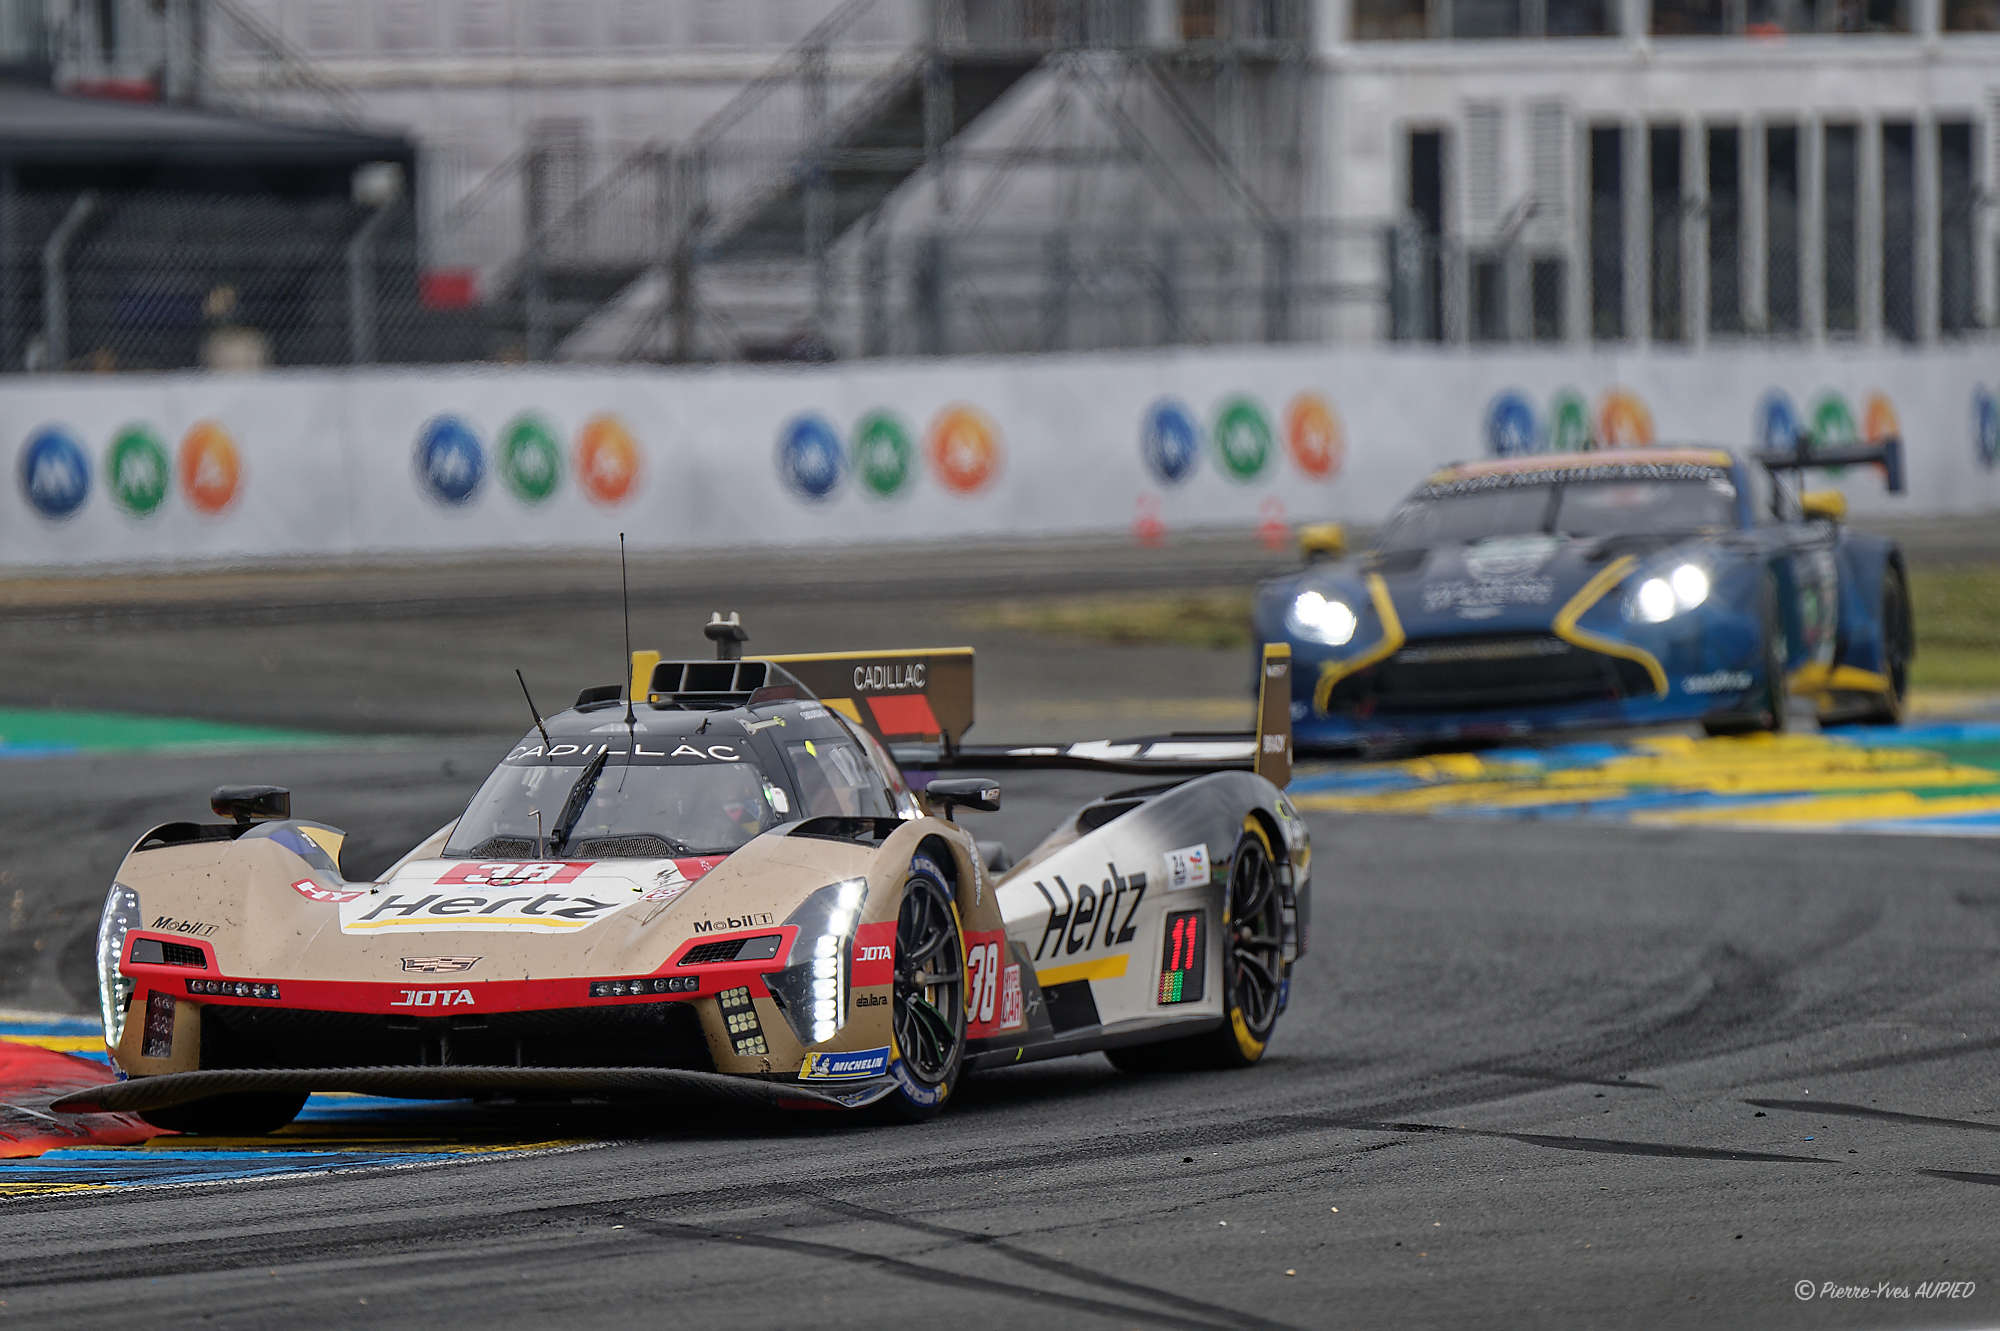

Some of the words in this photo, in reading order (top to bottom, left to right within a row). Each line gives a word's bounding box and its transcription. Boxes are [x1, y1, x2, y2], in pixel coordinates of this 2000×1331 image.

[853, 664, 926, 690] CADILLAC
[506, 744, 740, 760] CADILLAC
[464, 863, 567, 882] 38
[359, 893, 619, 920] Hertz
[1033, 862, 1147, 961] Hertz
[151, 916, 203, 935] Mobil
[693, 914, 753, 933] Mobil
[1171, 916, 1197, 970] 11
[856, 946, 891, 961] JOTA
[967, 943, 998, 1022] 38
[391, 990, 475, 1006] JOTA
[831, 1056, 884, 1072] MICHELIN
